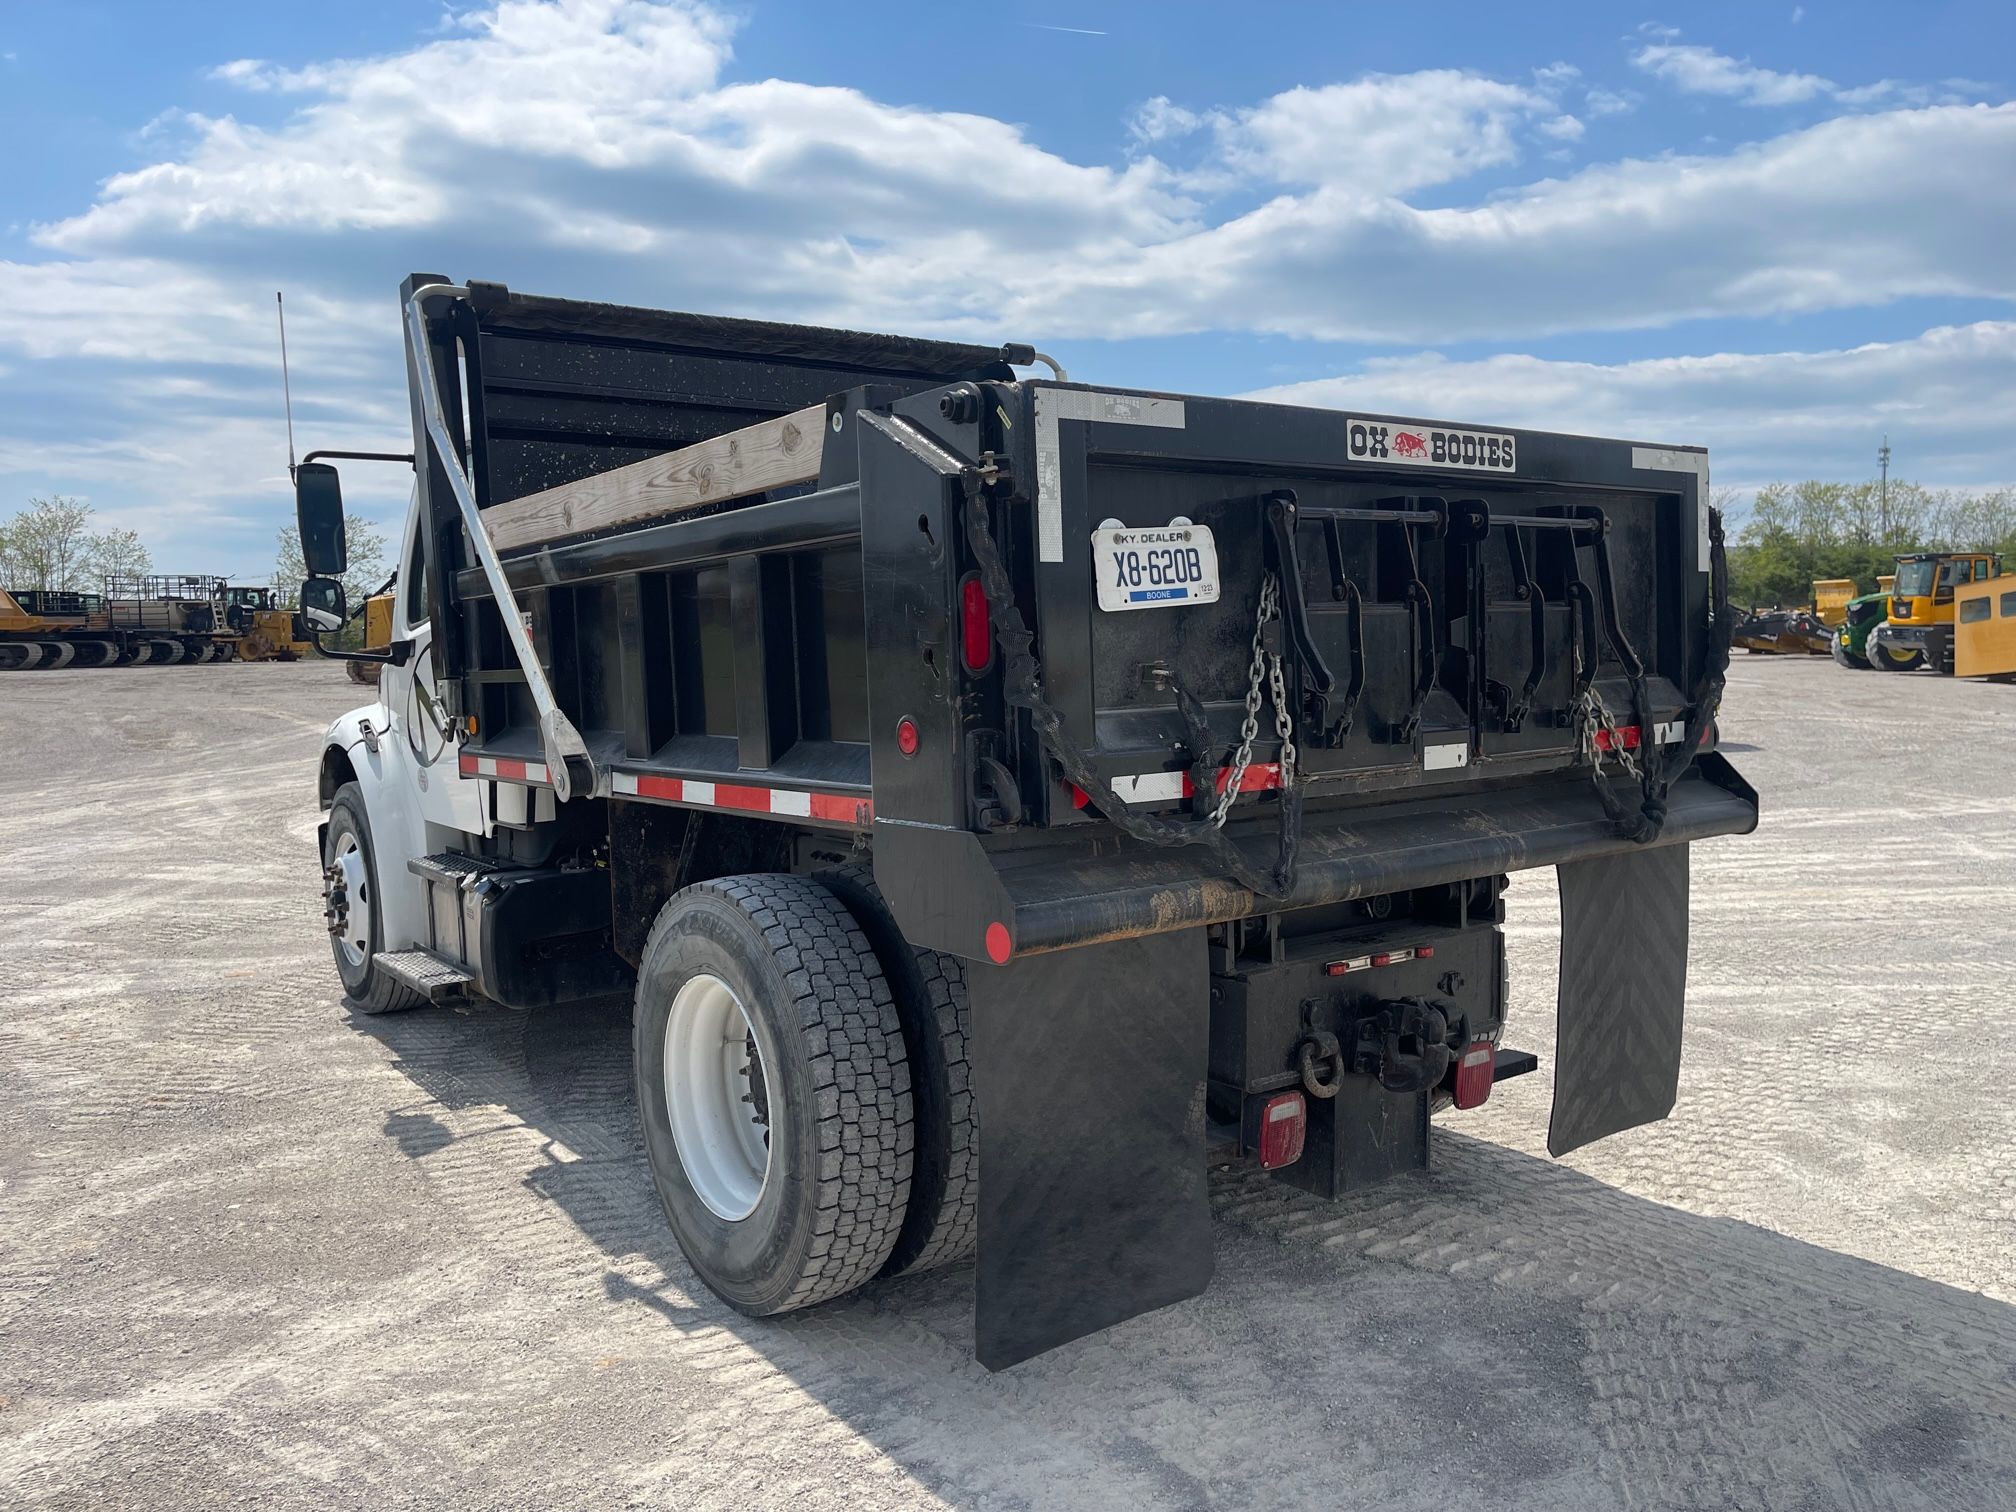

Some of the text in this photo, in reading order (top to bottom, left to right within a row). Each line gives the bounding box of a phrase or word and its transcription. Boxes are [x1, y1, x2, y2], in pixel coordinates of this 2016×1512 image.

[1350, 424, 1514, 468] OX BODIES
[1120, 533, 1183, 544] KY. DEALER
[1113, 548, 1202, 588] X8-620B
[1146, 591, 1171, 600] BOONE
